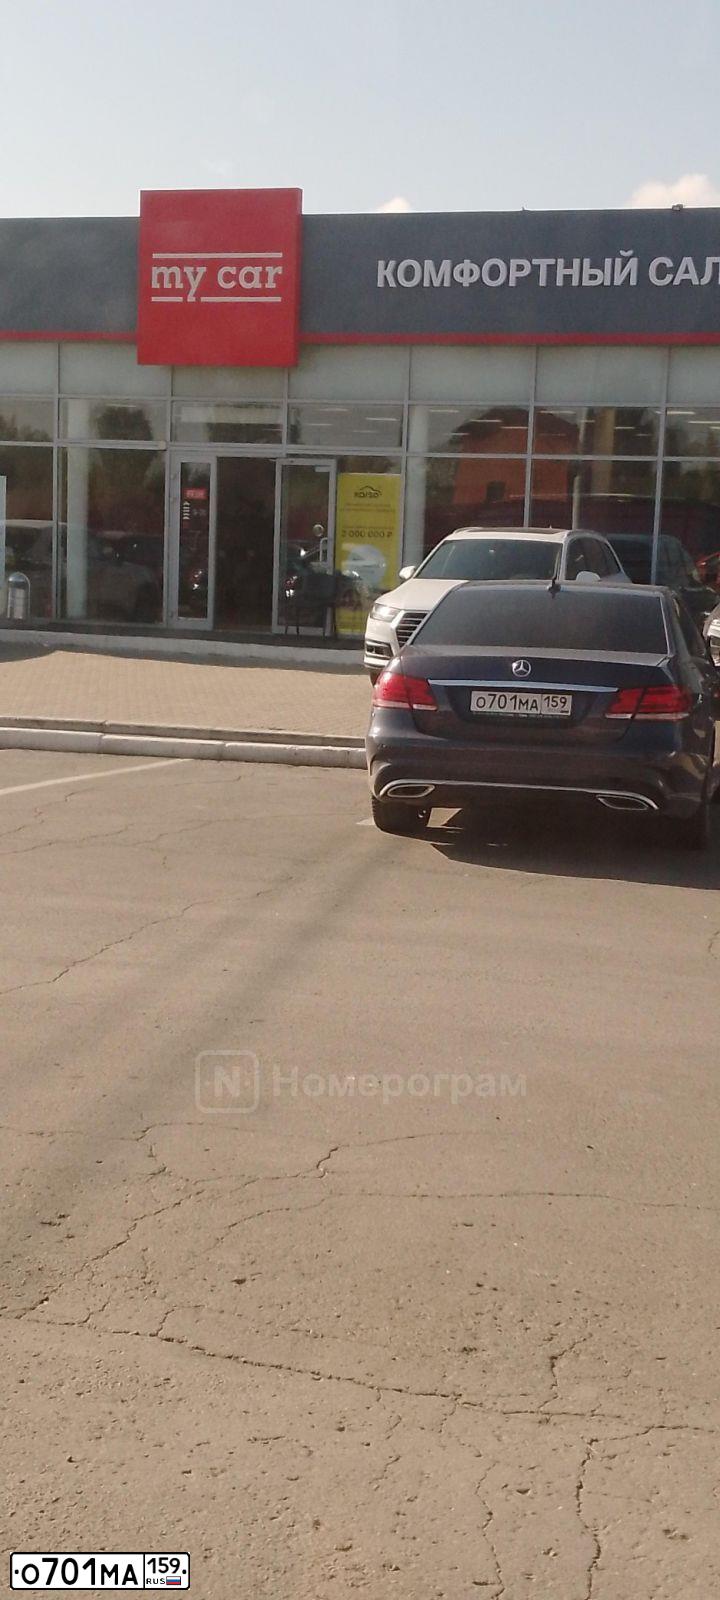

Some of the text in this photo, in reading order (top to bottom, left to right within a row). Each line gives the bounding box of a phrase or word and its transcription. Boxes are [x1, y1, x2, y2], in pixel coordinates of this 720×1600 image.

[151, 266, 283, 302] my car
[376, 249, 638, 287] КОМФОРТНЫЙ
[476, 693, 567, 711] О701МА 159
